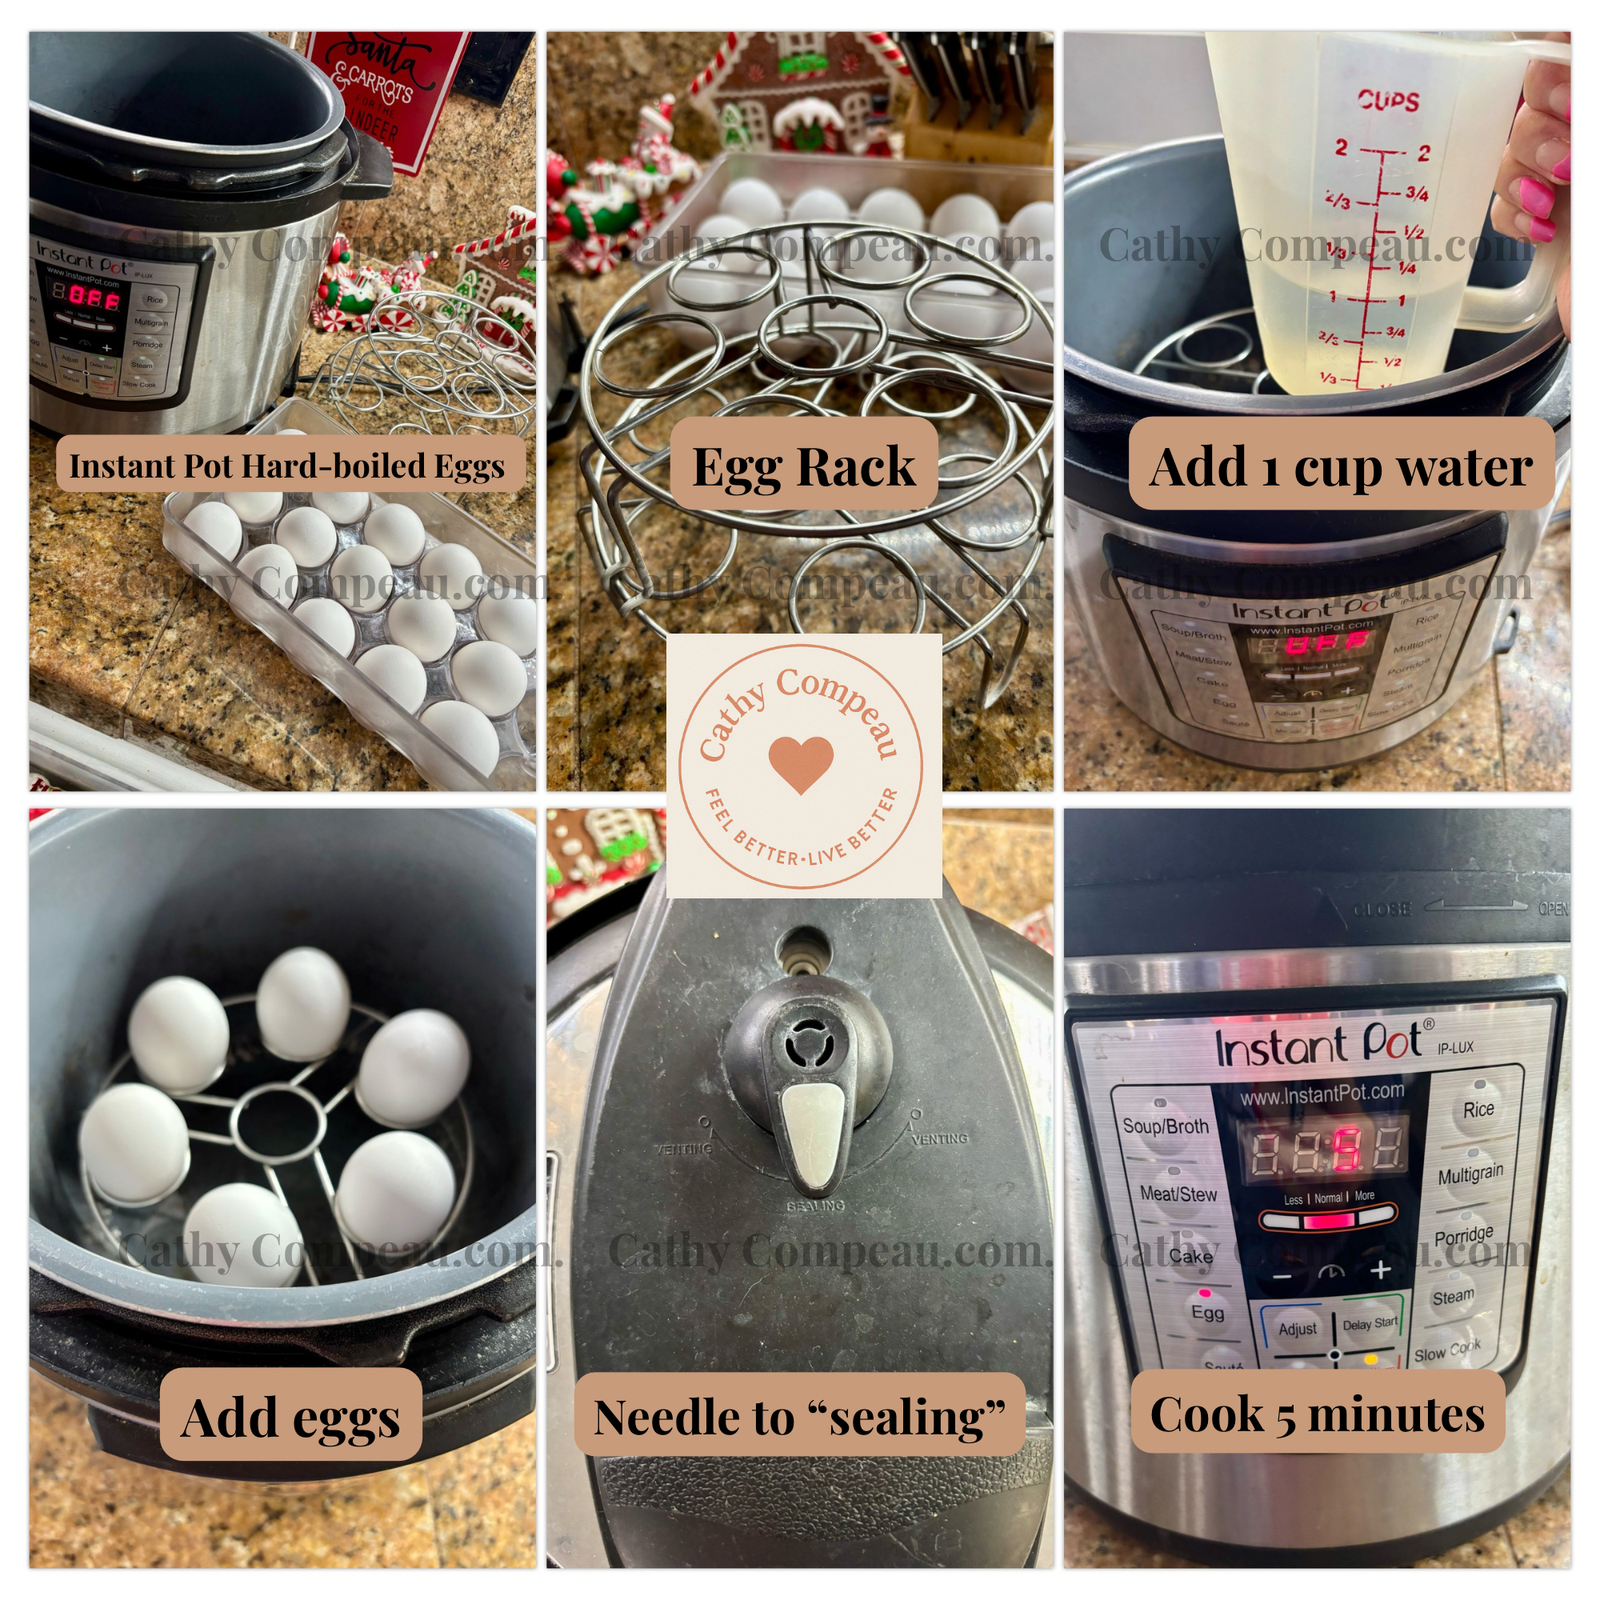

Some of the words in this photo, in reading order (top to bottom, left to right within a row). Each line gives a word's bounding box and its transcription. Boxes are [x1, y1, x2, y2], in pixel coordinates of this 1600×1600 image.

[325, 32, 436, 91] Santa
[349, 65, 414, 106] CARROTS
[355, 94, 375, 109] FOR
[378, 103, 395, 119] THE
[1358, 88, 1420, 113] CUPS
[345, 103, 398, 143] INDEER
[1335, 138, 1348, 156] 2
[1417, 144, 1431, 162] 2
[1405, 185, 1429, 202] 3/4
[1404, 224, 1424, 240] 1/2
[36, 240, 94, 270] Instant
[1326, 241, 1347, 260] 1/3
[134, 271, 153, 279] IP-LUX
[1398, 260, 1416, 275] 1/4
[47, 266, 120, 289] www.InstantPot.com
[69, 284, 120, 310] OFF
[146, 295, 164, 304] Rice
[1329, 290, 1336, 302] 1
[1398, 294, 1406, 307] 1
[134, 316, 169, 327] Multigrain
[1386, 326, 1405, 338] 3/4
[132, 339, 163, 349] Porridge
[61, 354, 79, 364] Adjust
[131, 361, 153, 369] Steam
[1384, 357, 1402, 367] 1/2
[122, 380, 138, 388] Slow
[139, 381, 156, 389] Cook
[1320, 371, 1337, 385] 1/3
[1232, 602, 1332, 620] Instant
[1415, 612, 1440, 626] Rice
[1161, 623, 1227, 642] Soup/Broth
[1250, 620, 1374, 635] www.InstantPot.com
[1394, 633, 1442, 654] Multigrain
[1175, 650, 1232, 667] Meat/Stew
[1387, 656, 1431, 676] Porridge
[1196, 676, 1229, 688] Cake
[1213, 698, 1237, 709] Egg
[1353, 901, 1413, 917] CLOSE
[1538, 901, 1570, 917] OPEN
[1215, 1026, 1349, 1067] Instant
[1437, 1040, 1475, 1056] IP-LUX
[1240, 1081, 1405, 1107] www.InstantPot.com
[1463, 1101, 1495, 1119] Rice
[1123, 1118, 1210, 1137] Soup/Broth
[911, 1133, 969, 1145] VENTING
[654, 1142, 713, 1156] VENTING
[1438, 1163, 1504, 1187] Multigrain
[1140, 1185, 1218, 1203] Meat/Stew
[1284, 1194, 1304, 1206] Less
[1314, 1192, 1343, 1204] Normal
[1355, 1190, 1375, 1201] More
[786, 1200, 846, 1212] SEALING
[1434, 1225, 1494, 1247] Porridge
[1169, 1248, 1214, 1264] Cake
[1433, 1288, 1475, 1306] Steam
[1191, 1305, 1225, 1323] Egg
[1279, 1322, 1317, 1338] Adjust
[1343, 1319, 1372, 1333] Delay
[1374, 1316, 1398, 1329] Start
[1414, 1349, 1447, 1363] Slow
[1450, 1338, 1481, 1357] Cook
